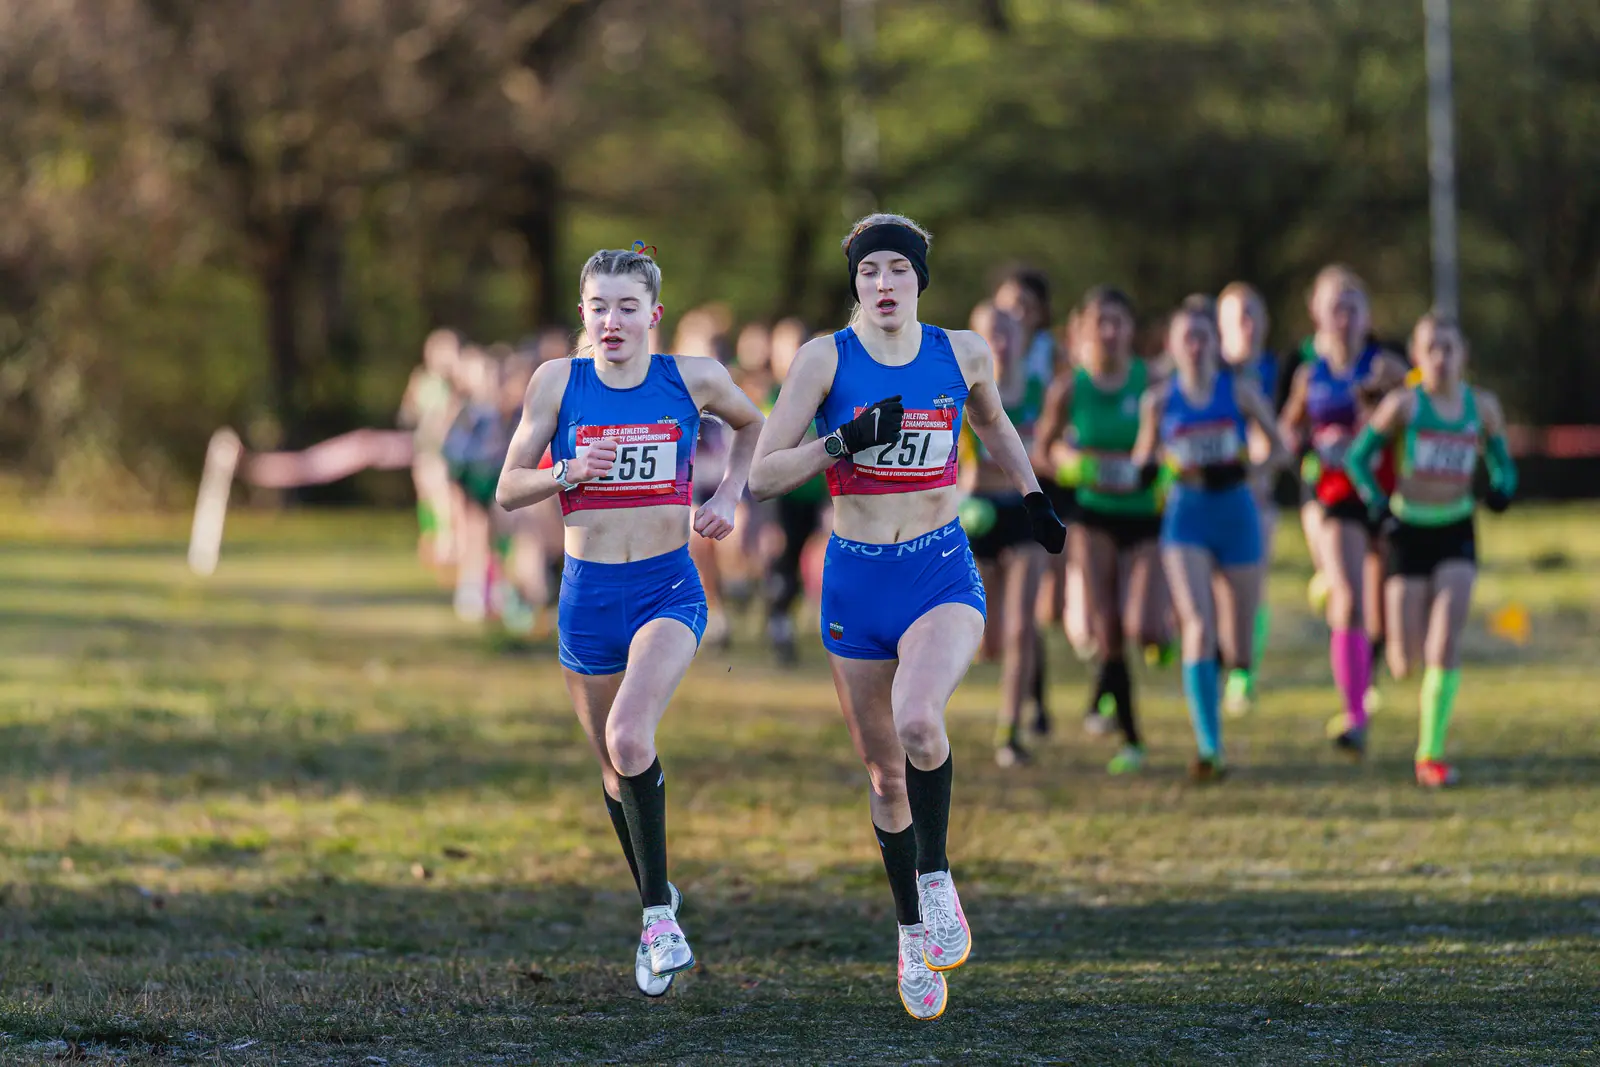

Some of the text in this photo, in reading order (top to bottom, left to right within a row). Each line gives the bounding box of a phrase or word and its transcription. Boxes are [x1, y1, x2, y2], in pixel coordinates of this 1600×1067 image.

[902, 412, 929, 420] THLETICS
[603, 427, 649, 436] ESSEX ATHLETICS
[626, 433, 671, 442] CHAMPIONSHIPS
[877, 432, 931, 467] 251
